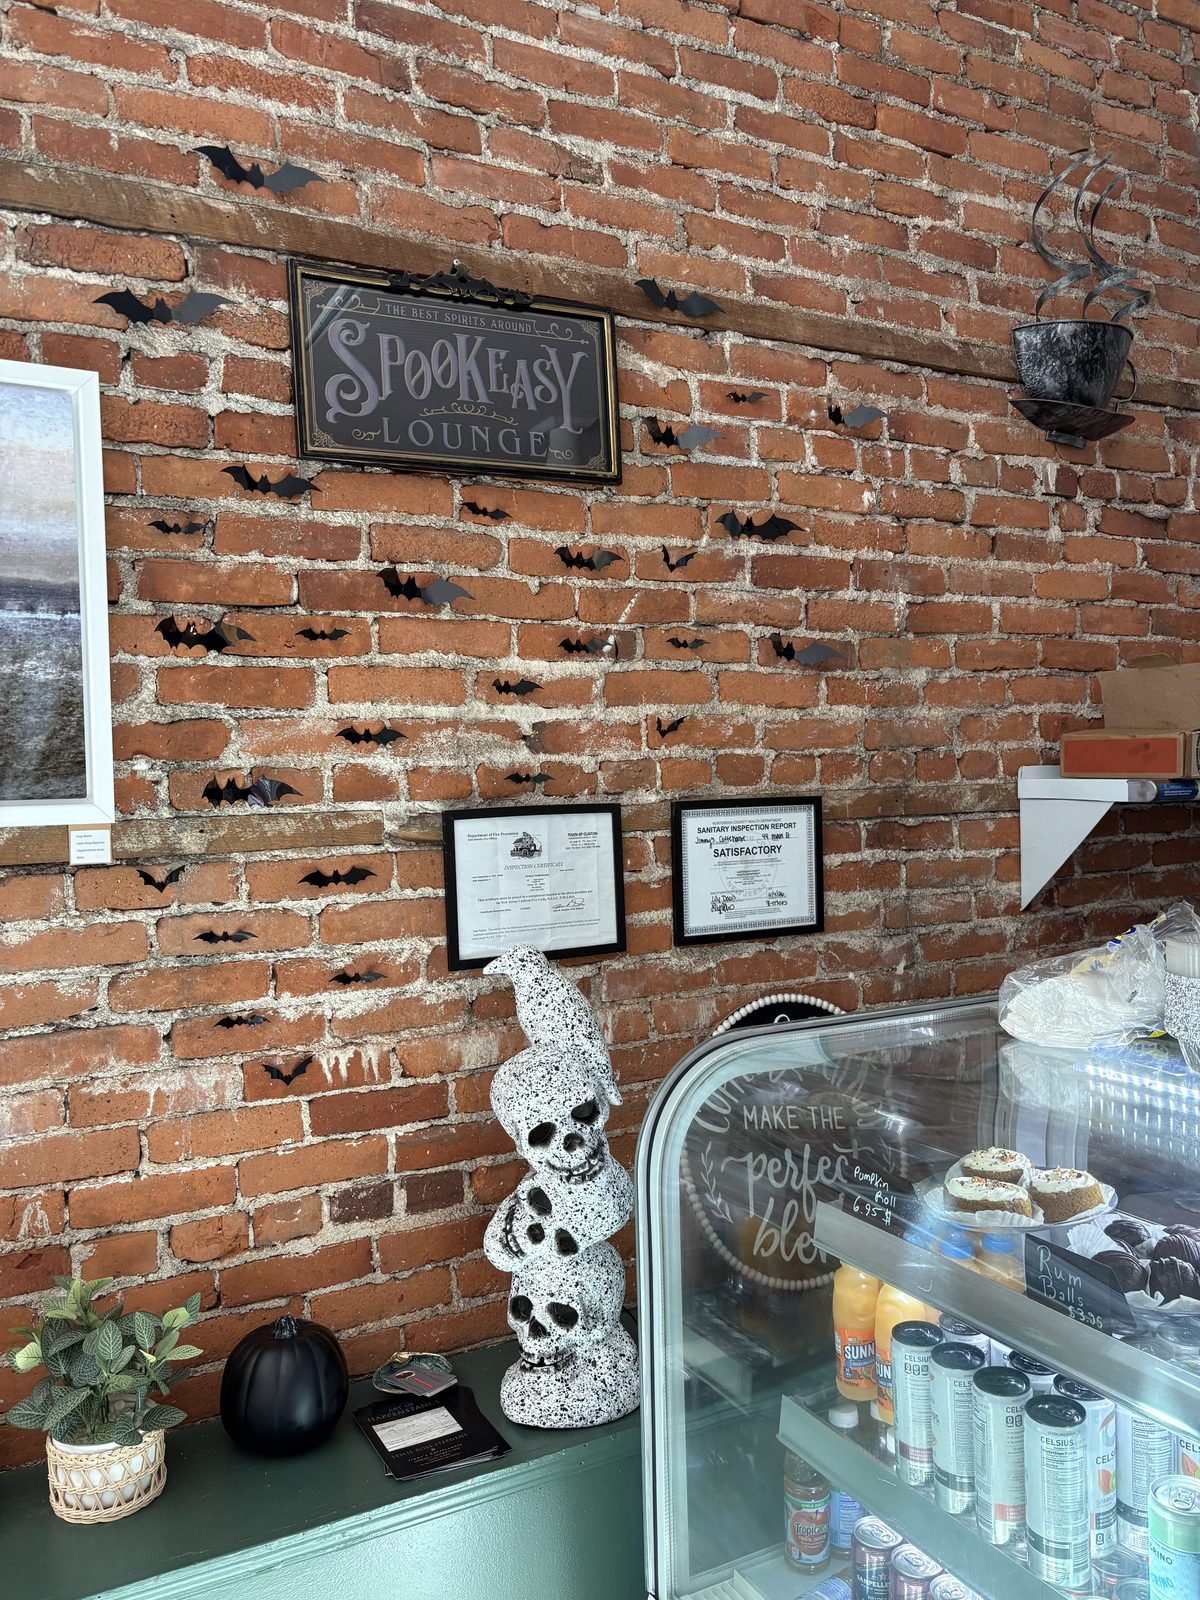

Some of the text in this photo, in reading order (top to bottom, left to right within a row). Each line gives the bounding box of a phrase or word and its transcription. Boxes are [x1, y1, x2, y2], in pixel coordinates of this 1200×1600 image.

[384, 303, 532, 334] THE BEST SPIRITS AROUND
[324, 318, 590, 434] SPOOKEASY
[382, 416, 548, 459] LOUNGE
[697, 822, 797, 834] SANITARY INSPECTION REPORT
[713, 845, 782, 858] SATISFACTORY
[743, 1105, 846, 1131] MAKE THE
[875, 1190, 897, 1208] Roll
[1037, 1245, 1082, 1289] Rum
[1038, 1274, 1084, 1307] Balls
[1068, 1305, 1103, 1329] $3.95
[1040, 1435, 1074, 1447] CELSIUS
